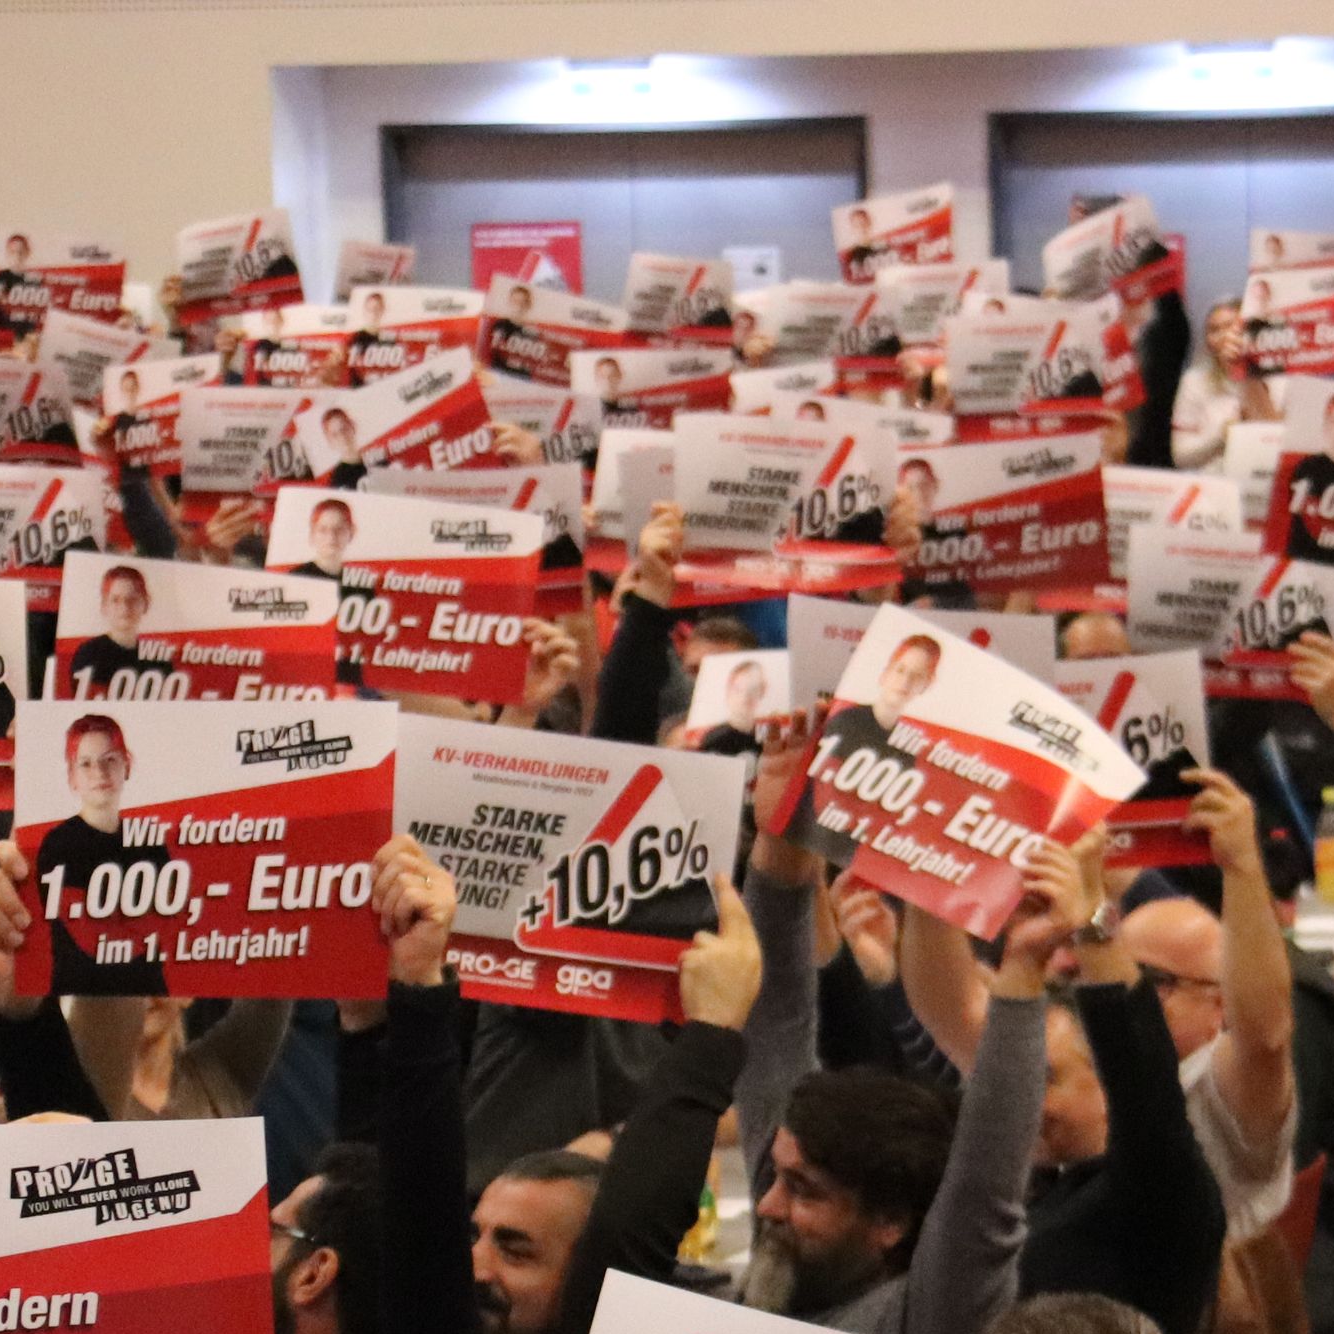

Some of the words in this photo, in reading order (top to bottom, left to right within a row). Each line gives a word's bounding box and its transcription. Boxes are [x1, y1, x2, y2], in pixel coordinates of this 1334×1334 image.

[429, 426, 493, 472] Euro
[1021, 519, 1100, 554] Euro
[341, 566, 376, 589] Wir
[382, 568, 464, 596] fordern
[428, 602, 522, 646] Euro
[137, 639, 173, 662] Wir
[182, 641, 265, 668] fordern
[372, 645, 473, 674] Lehrjahr!
[432, 746, 611, 785] KV-VERHANDLUNGEN
[887, 722, 926, 755] Wir
[926, 736, 1012, 792] fordern
[806, 734, 944, 820] 1.000,-
[121, 816, 171, 848] Wir
[178, 813, 286, 846] fordern
[472, 803, 567, 837] STARKE
[408, 821, 546, 864] MENSCHEN,
[817, 800, 851, 836] im
[867, 825, 977, 888] Lehrjahr!
[40, 858, 230, 926] 1.000,-
[247, 853, 374, 912] Euro
[438, 854, 529, 888] STARKE
[520, 820, 709, 926] +10,6%
[95, 934, 132, 965] im
[143, 931, 167, 962] 1.
[175, 926, 310, 966] Lehrjahr!
[446, 950, 539, 982] PRO-GE
[555, 964, 613, 996] gpa
[28, 1201, 49, 1214] YOU
[53, 1198, 78, 1210] WILL
[81, 1190, 117, 1204] NEVER
[119, 1184, 152, 1198] WORK
[154, 1178, 191, 1193] ALONE
[101, 1193, 187, 1221] JUGEND
